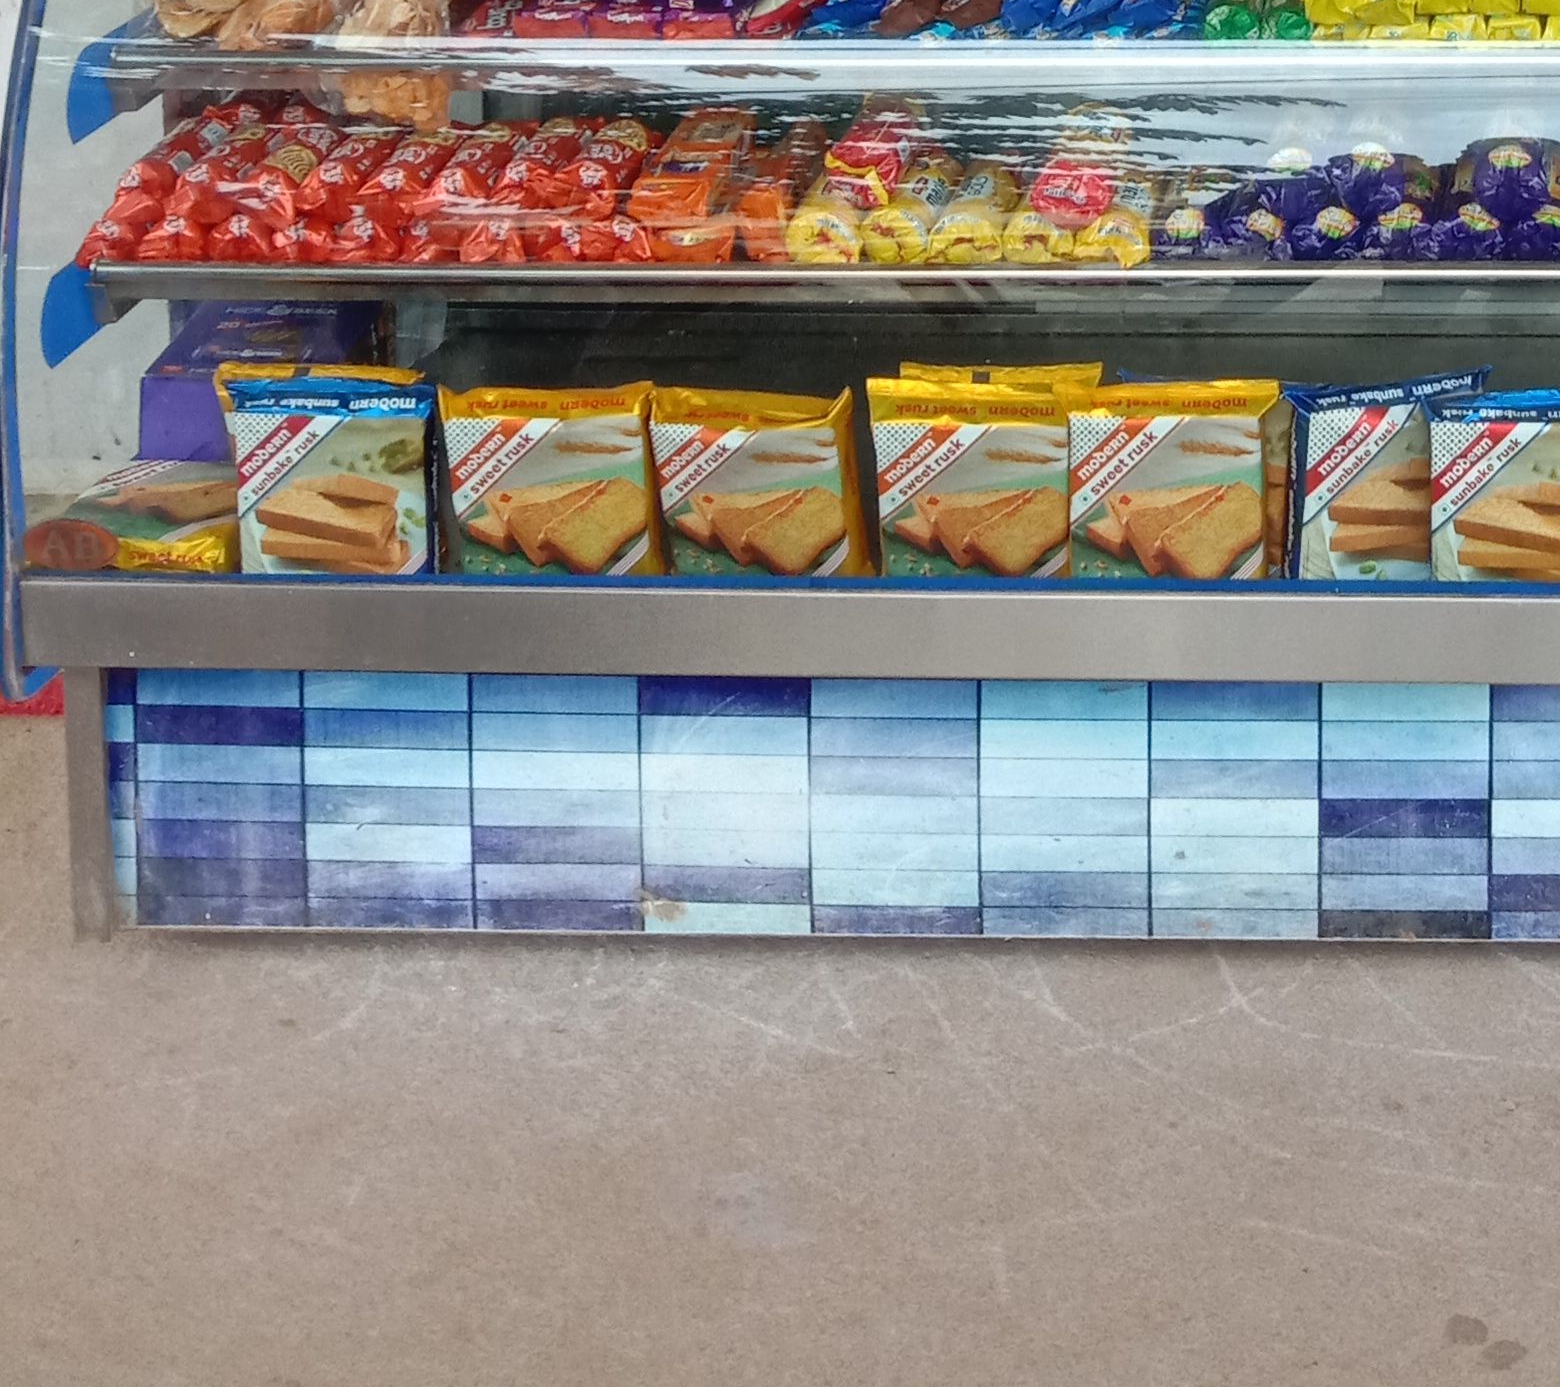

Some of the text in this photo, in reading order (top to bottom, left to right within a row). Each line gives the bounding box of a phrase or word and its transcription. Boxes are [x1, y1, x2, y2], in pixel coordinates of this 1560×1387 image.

[240, 428, 291, 478] modern
[251, 429, 321, 497] sunbake rusk
[456, 433, 506, 482] modern
[470, 433, 536, 495] sweet rusk
[662, 439, 705, 479] modern
[675, 442, 732, 494] sweet rusk
[884, 437, 937, 484] modern
[898, 437, 967, 499] sweet rusk
[1077, 430, 1131, 481] modern
[1090, 430, 1159, 497] sweet rusk
[1317, 421, 1372, 477] modern
[1325, 418, 1400, 495] sunbake rusk
[1440, 434, 1494, 490] modern
[1449, 436, 1523, 508] sunbake rusk
